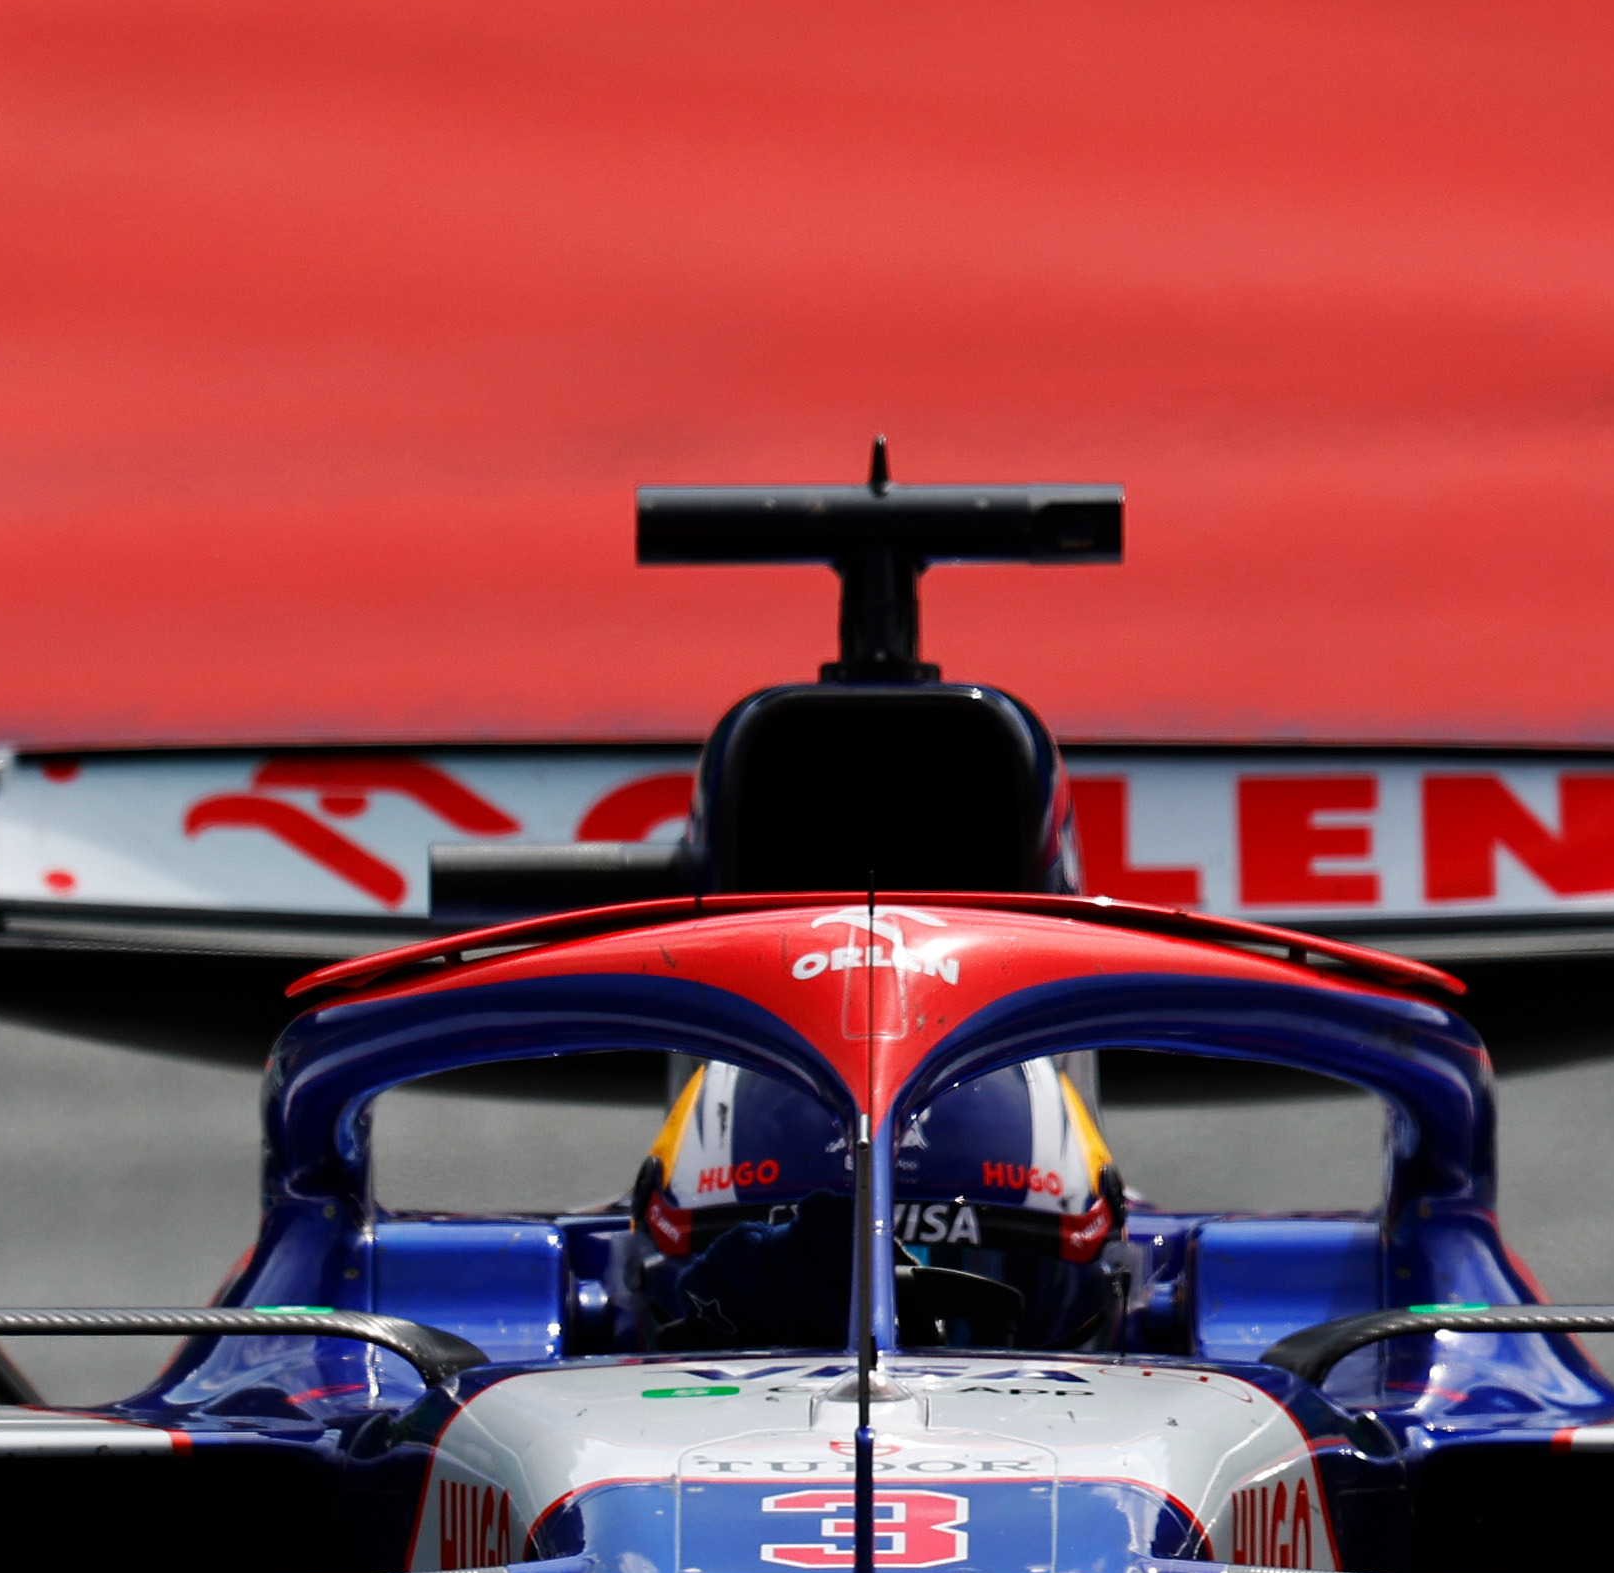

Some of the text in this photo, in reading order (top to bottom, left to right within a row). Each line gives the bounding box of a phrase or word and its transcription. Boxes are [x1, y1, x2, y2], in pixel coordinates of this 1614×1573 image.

[791, 946, 960, 985] ORLEN
[698, 1159, 780, 1193] HUGO
[982, 1161, 1063, 1196] HUGO
[696, 1461, 1036, 1473] TUDOR
[761, 1489, 969, 1569] 3
